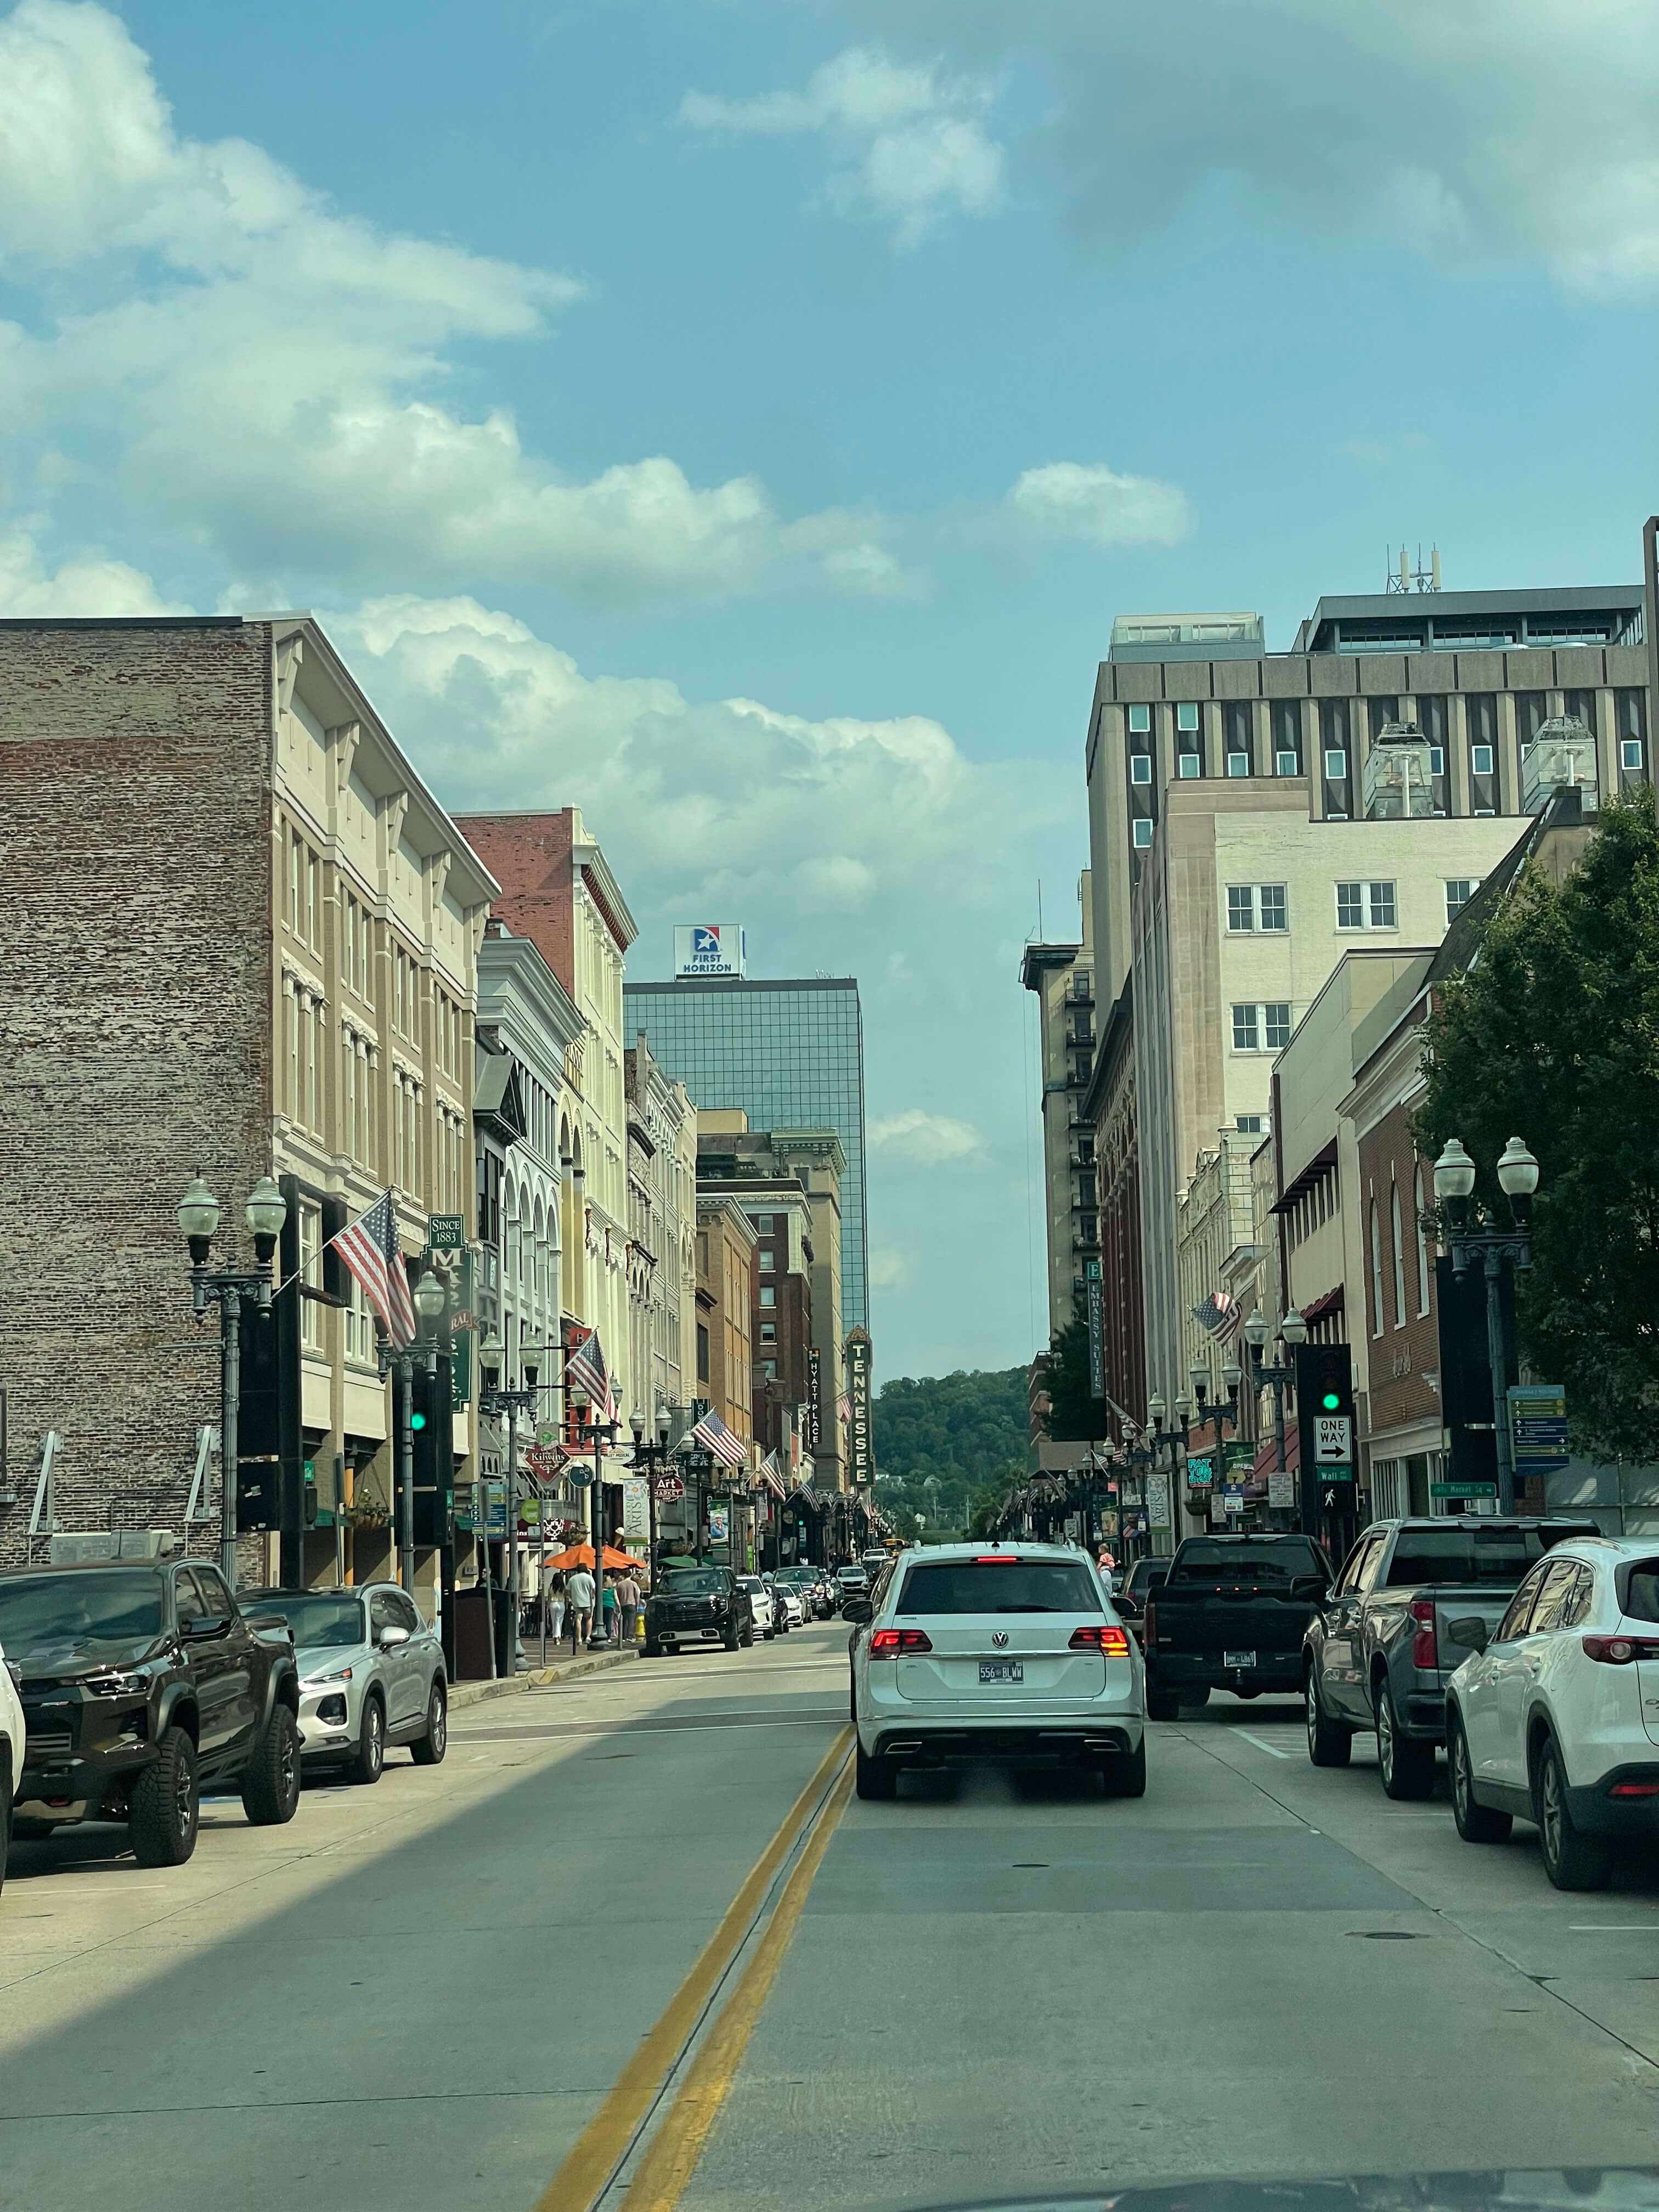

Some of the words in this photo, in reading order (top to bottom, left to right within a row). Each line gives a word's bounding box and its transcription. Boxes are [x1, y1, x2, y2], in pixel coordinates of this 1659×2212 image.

[693, 954, 722, 963] FIRST
[684, 964, 731, 973] HORIZON
[437, 1232, 456, 1243] 1883
[1091, 1285, 1101, 1338] EMBASSY
[1093, 1344, 1102, 1390] SUITES
[853, 1345, 867, 1482] TENNESSEE
[1321, 1420, 1345, 1431] ONE
[1321, 1432, 1345, 1442] WAY
[532, 1452, 565, 1462] Kilwins
[1188, 1459, 1212, 1468] FAT
[1189, 1475, 1212, 1483] DAY
[1321, 1472, 1337, 1480] Wall
[657, 1479, 676, 1488] Art
[1153, 1496, 1165, 1523] ARTS
[629, 1502, 642, 1534] ARTS
[980, 1667, 996, 1678] 556
